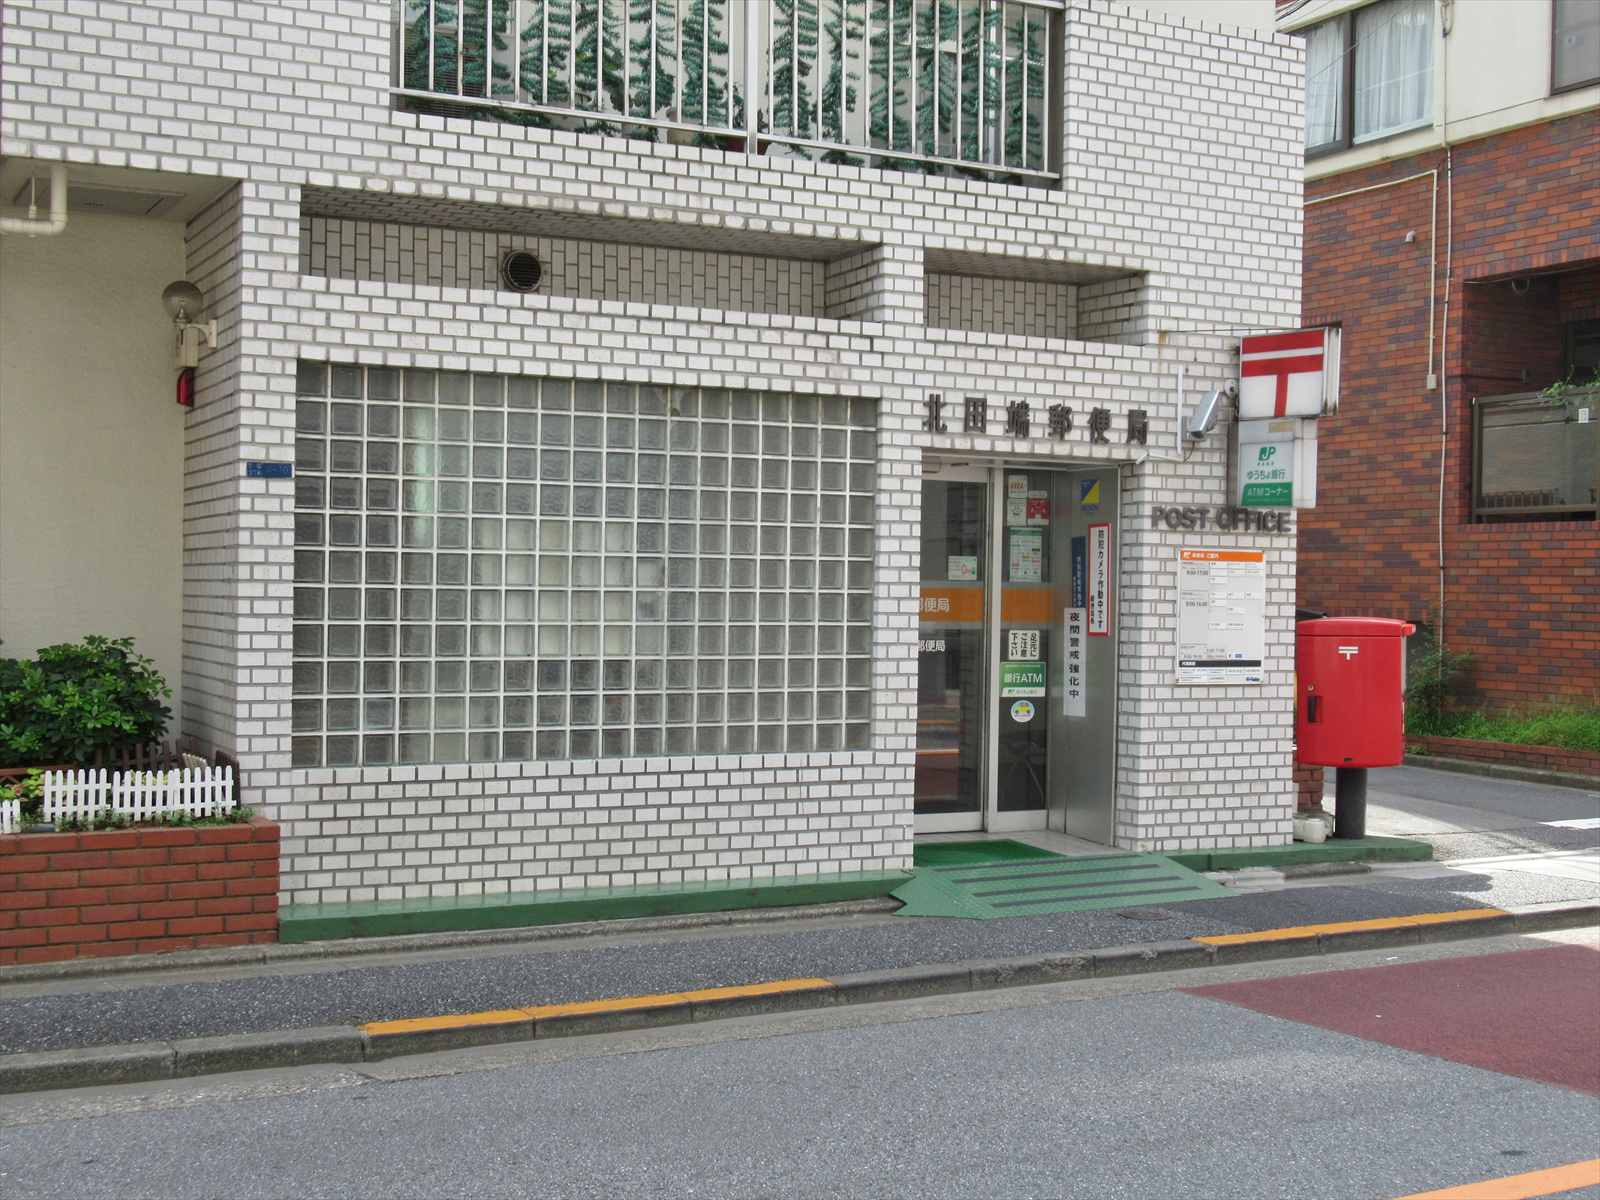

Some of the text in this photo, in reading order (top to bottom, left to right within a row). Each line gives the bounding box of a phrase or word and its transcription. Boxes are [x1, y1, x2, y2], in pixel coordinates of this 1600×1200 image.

[923, 393, 1148, 445] 北田端郵便局
[1246, 469, 1286, 480] ゆうちょ銀行
[1247, 487, 1289, 496] ATMコーナー
[1151, 506, 1292, 533] POST OFFICE
[1097, 529, 1105, 629] 防犯カメラ作動中です
[1020, 633, 1028, 658] ご注意
[1069, 612, 1080, 699] 夜間警戒強化中
[1003, 673, 1043, 683] 銀行ATM
